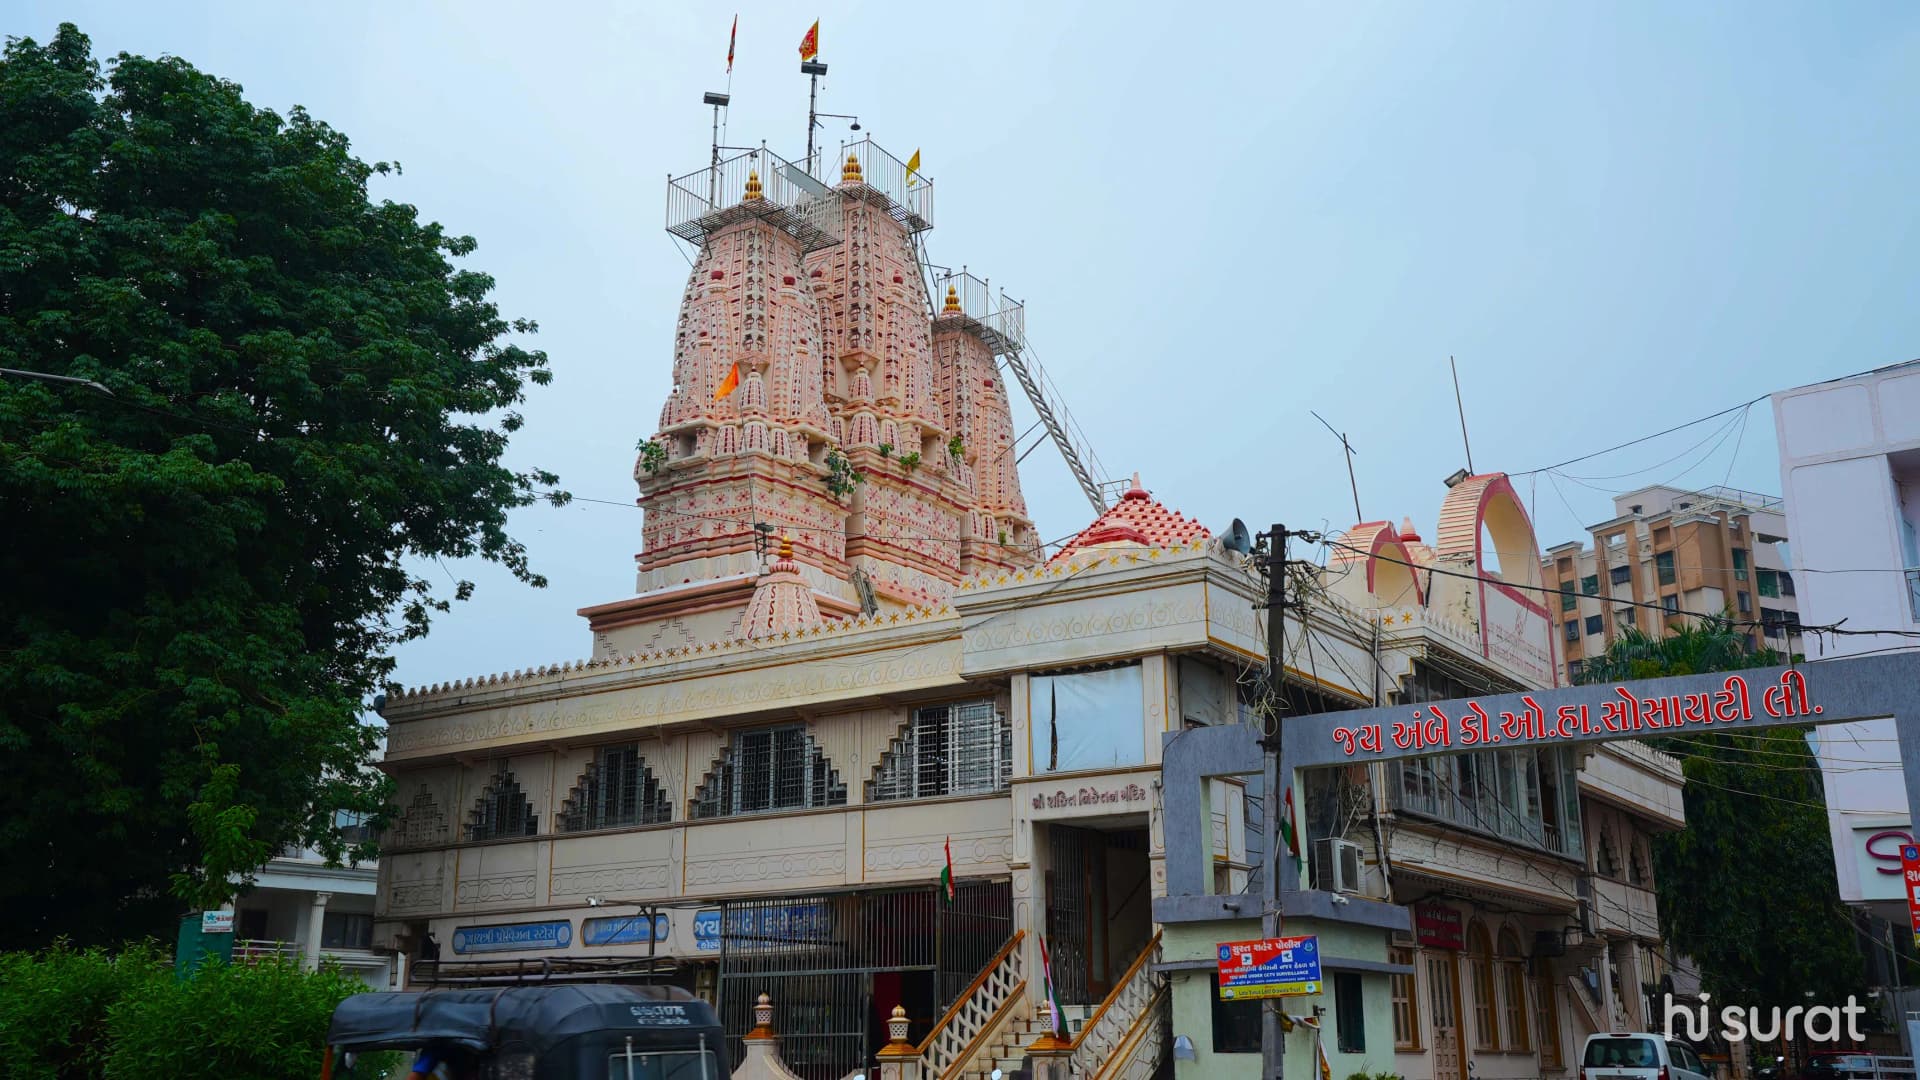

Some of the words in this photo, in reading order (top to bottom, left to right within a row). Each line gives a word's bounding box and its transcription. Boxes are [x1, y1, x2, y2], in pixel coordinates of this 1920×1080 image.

[1332, 725, 1384, 755] જય
[1391, 705, 1451, 749] અંબે
[1763, 668, 1823, 717] લી.
[1232, 944, 1251, 956] સુરત
[1253, 941, 1272, 951] શહેર
[1275, 939, 1301, 949] પોલીસ
